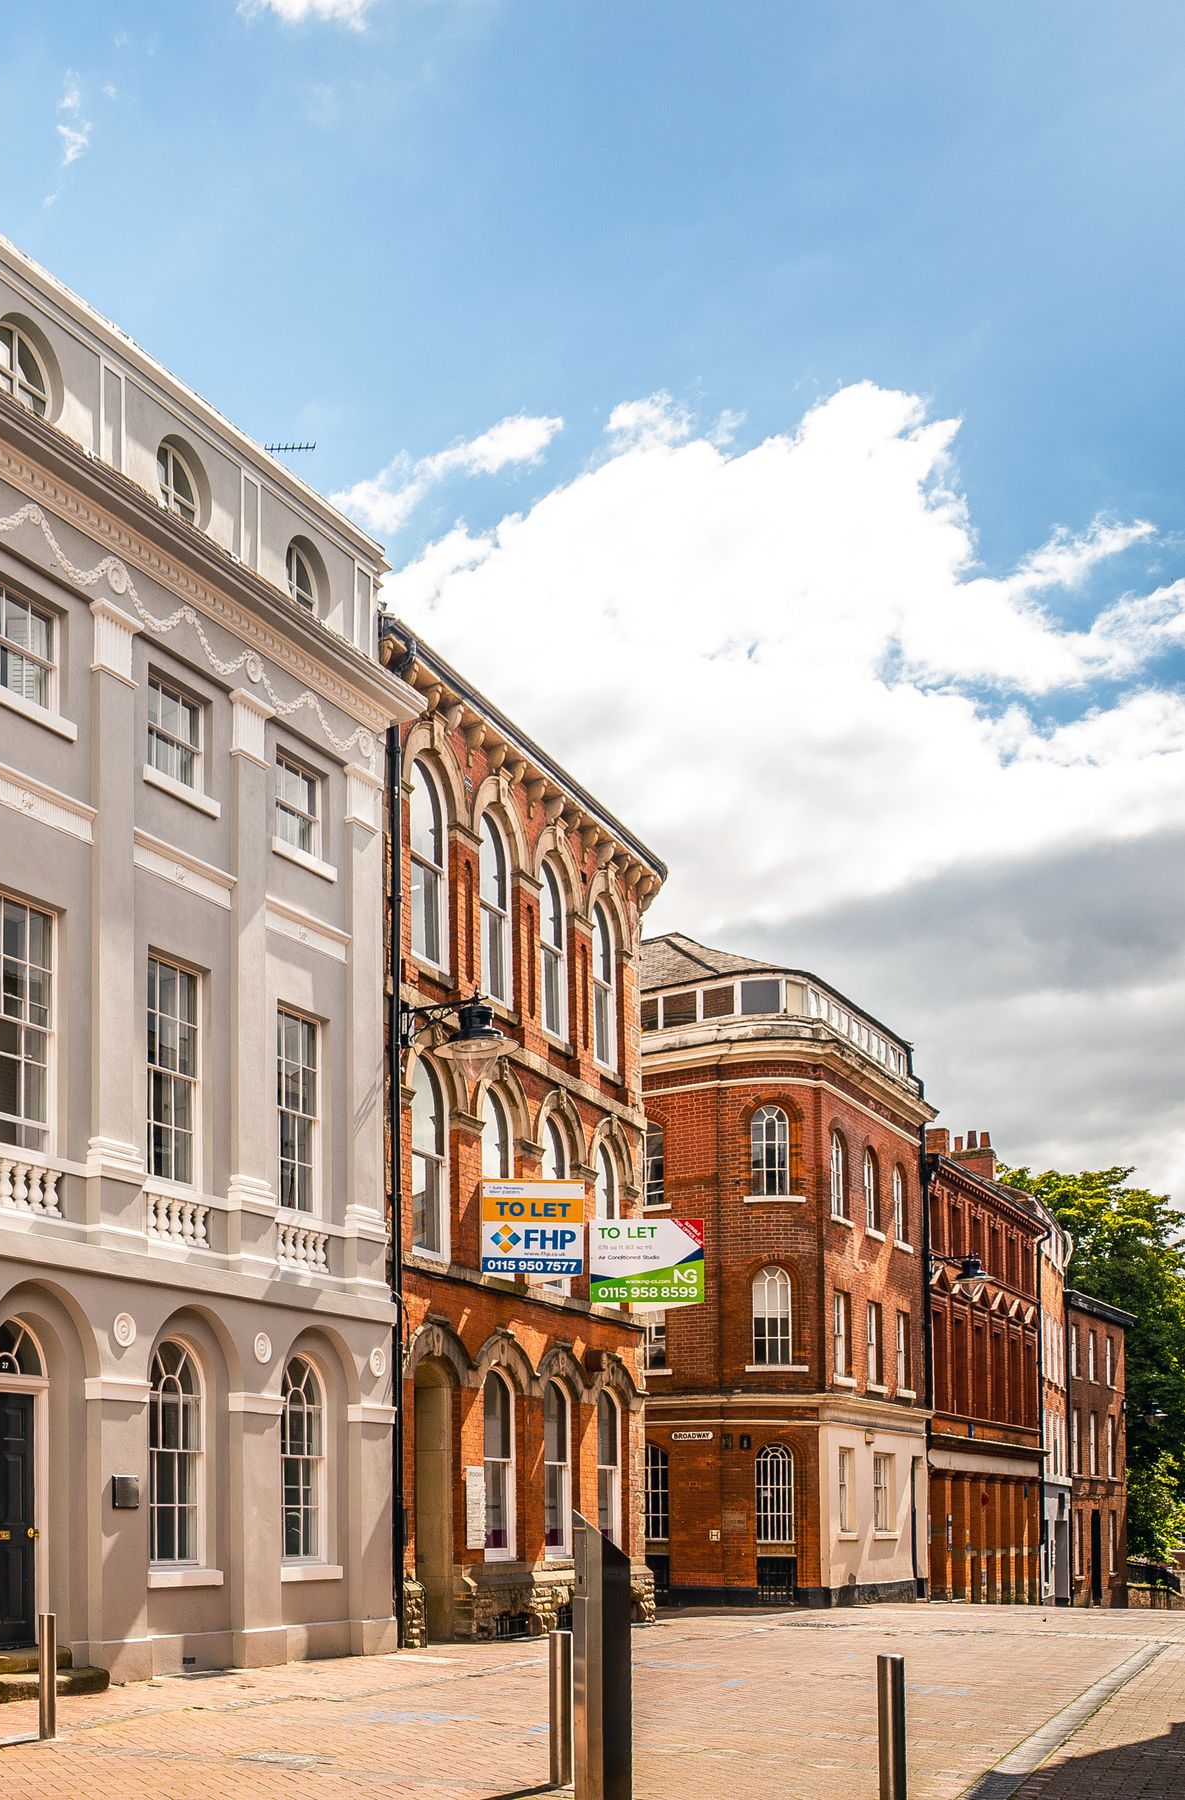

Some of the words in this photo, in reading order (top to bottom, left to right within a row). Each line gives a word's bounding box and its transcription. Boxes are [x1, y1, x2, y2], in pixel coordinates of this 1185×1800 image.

[496, 1202, 525, 1216] TO
[530, 1203, 571, 1217] LET
[524, 1229, 576, 1250] FHP
[598, 1227, 620, 1239] TO
[627, 1227, 657, 1238] LET
[487, 1260, 515, 1270] 0115
[518, 1261, 544, 1271] 950
[546, 1262, 577, 1271] 7577
[673, 1269, 697, 1284] NG
[598, 1287, 627, 1298] 0115
[630, 1287, 658, 1298] 958
[661, 1287, 698, 1298] 8599
